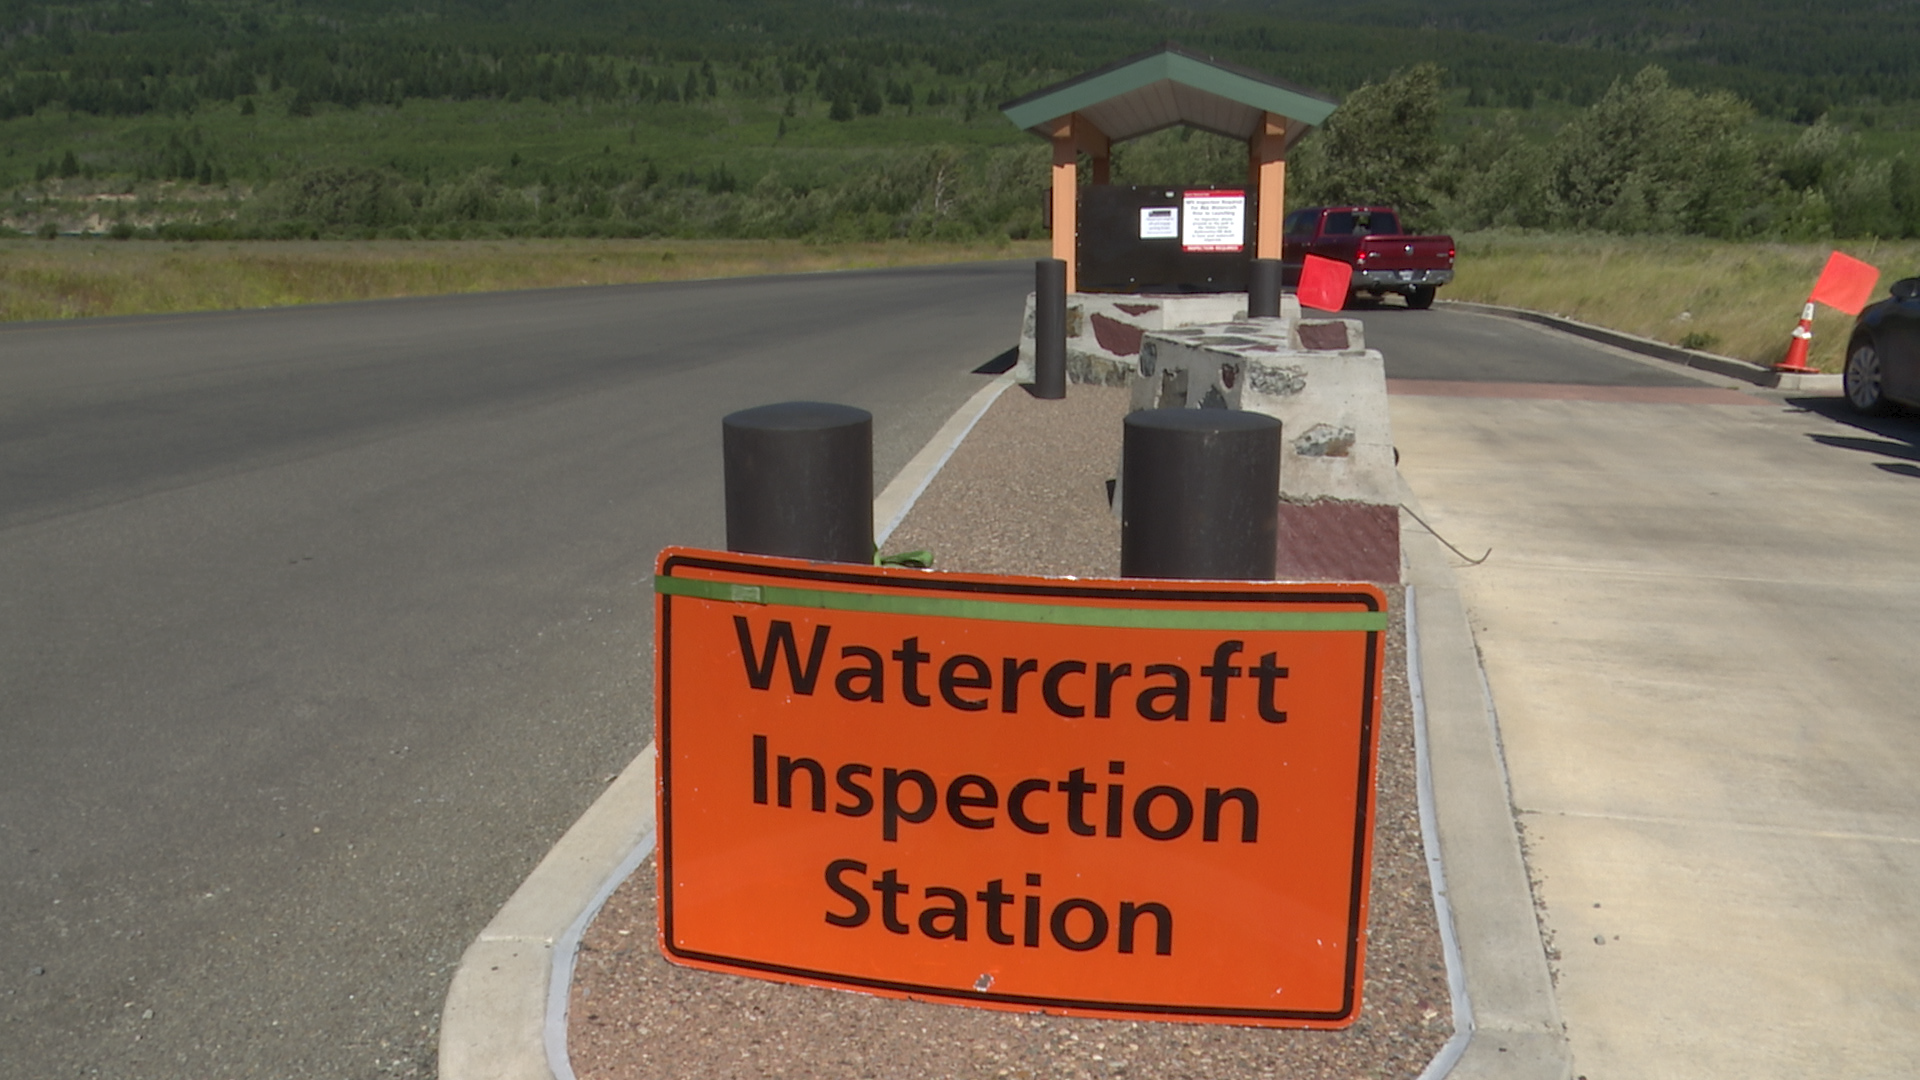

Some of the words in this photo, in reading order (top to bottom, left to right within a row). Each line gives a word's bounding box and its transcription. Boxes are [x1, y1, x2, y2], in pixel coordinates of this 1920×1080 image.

[733, 616, 1289, 724] Watercraft
[752, 735, 1259, 842] Inspection
[824, 859, 1173, 956] Station
